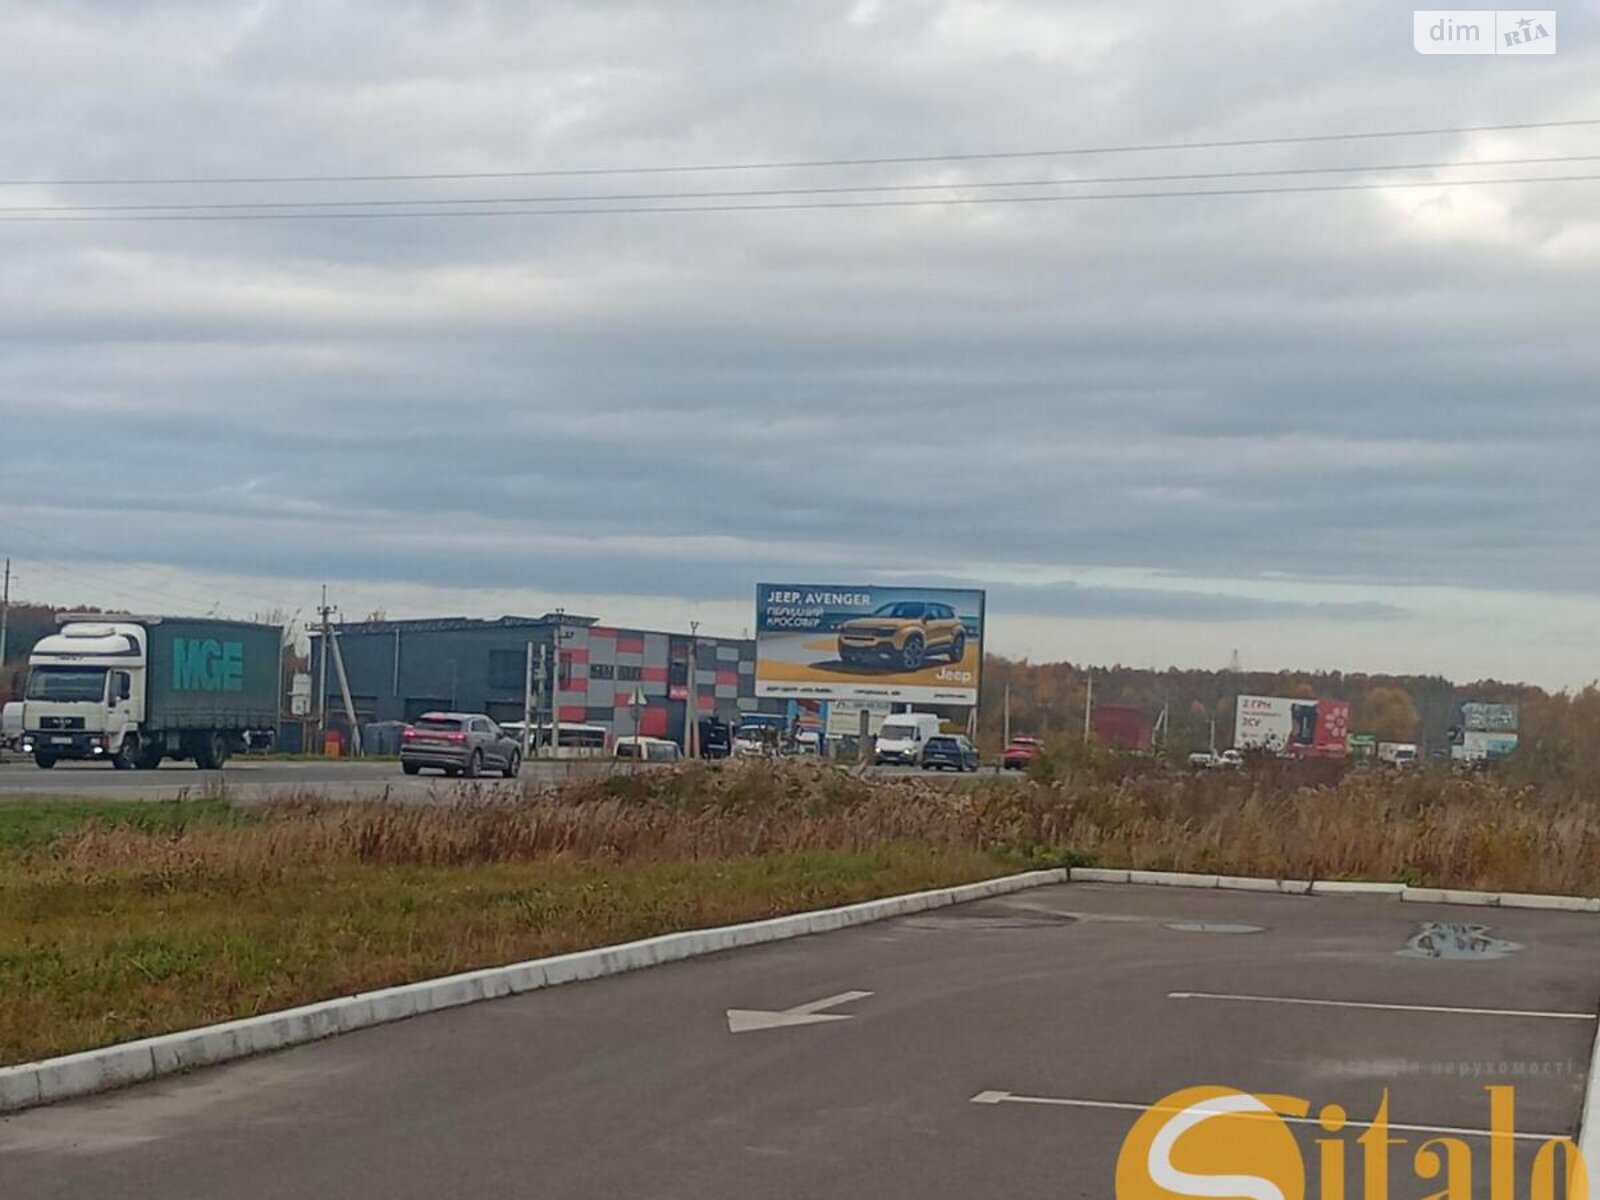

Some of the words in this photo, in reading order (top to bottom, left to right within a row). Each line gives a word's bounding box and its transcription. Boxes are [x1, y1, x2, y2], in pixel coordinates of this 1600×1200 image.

[805, 592, 871, 606] AVENGER
[172, 637, 244, 692] MGE
[935, 667, 972, 683] Jeep
